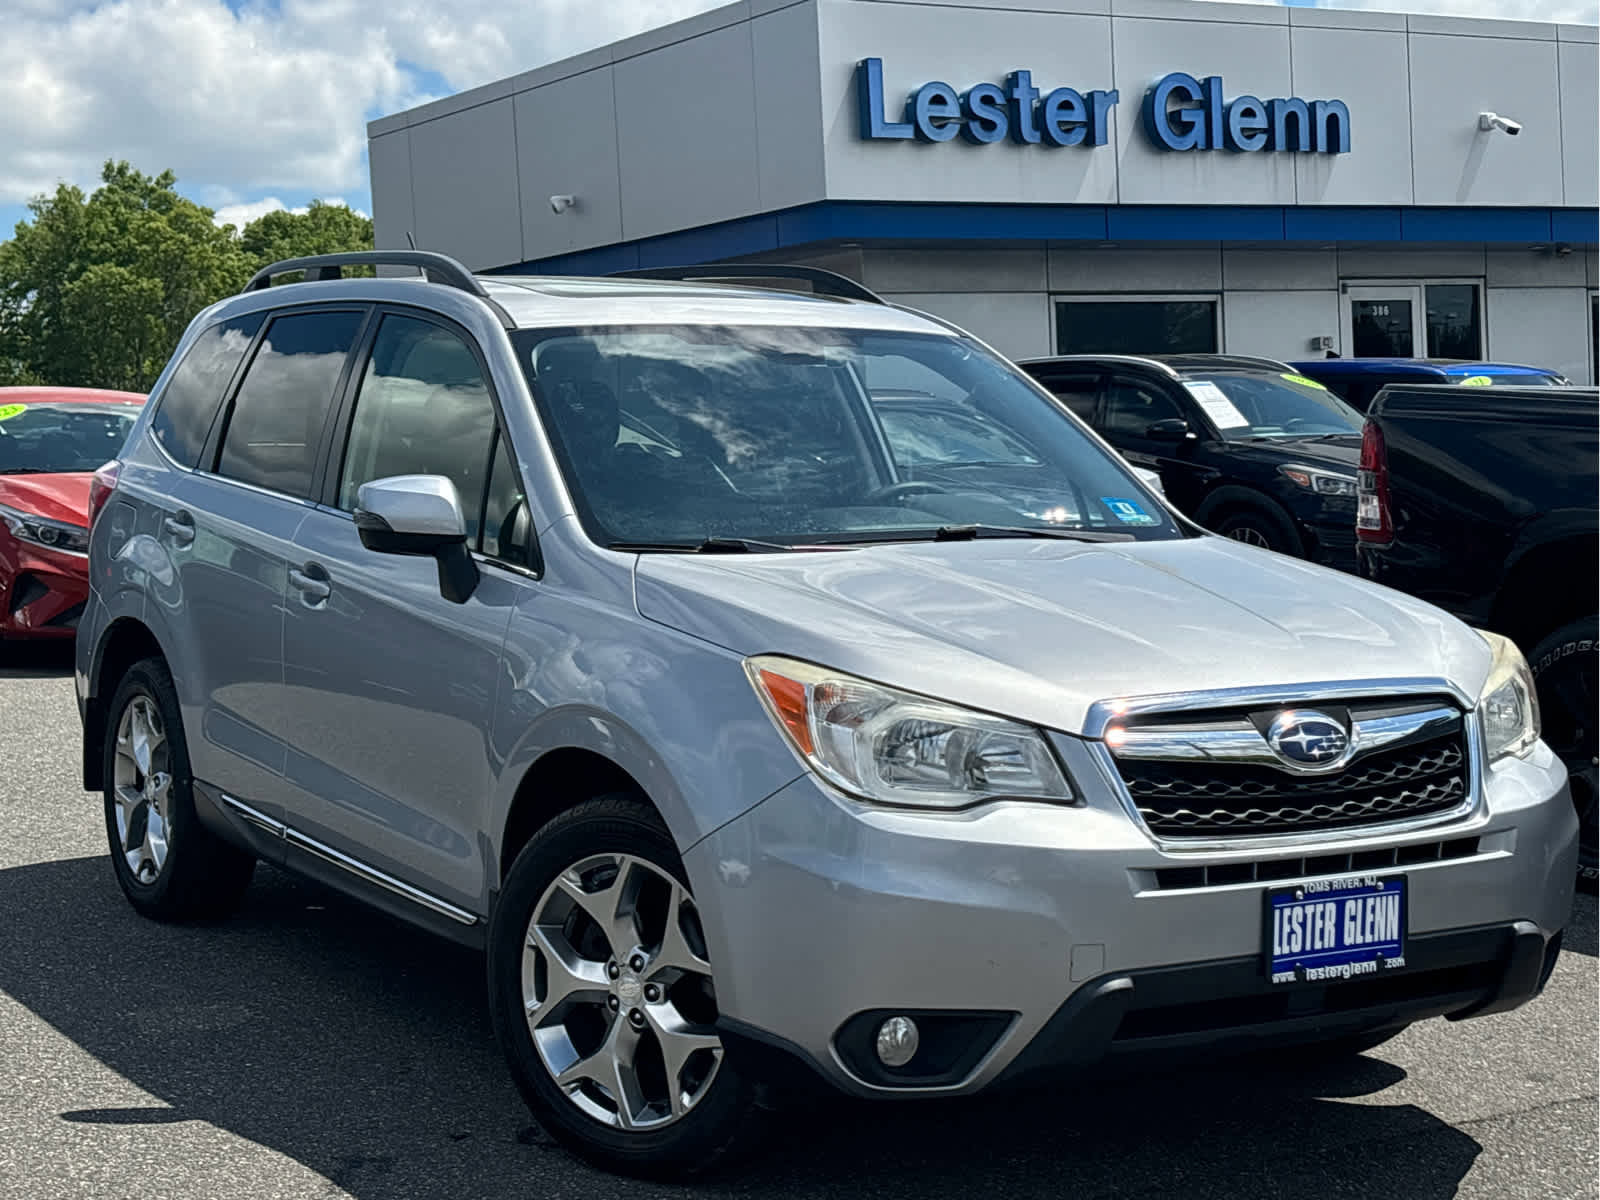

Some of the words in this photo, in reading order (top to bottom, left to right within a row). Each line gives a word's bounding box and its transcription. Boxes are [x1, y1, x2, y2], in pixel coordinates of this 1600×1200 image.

[856, 57, 1119, 146] Lester
[1145, 72, 1351, 153] Glenn
[1302, 881, 1331, 894] TOMS
[1365, 875, 1377, 887] NJ
[1273, 902, 1337, 956] LESTER
[1343, 894, 1399, 946] GLENN
[1305, 960, 1377, 981] lesterglenn
